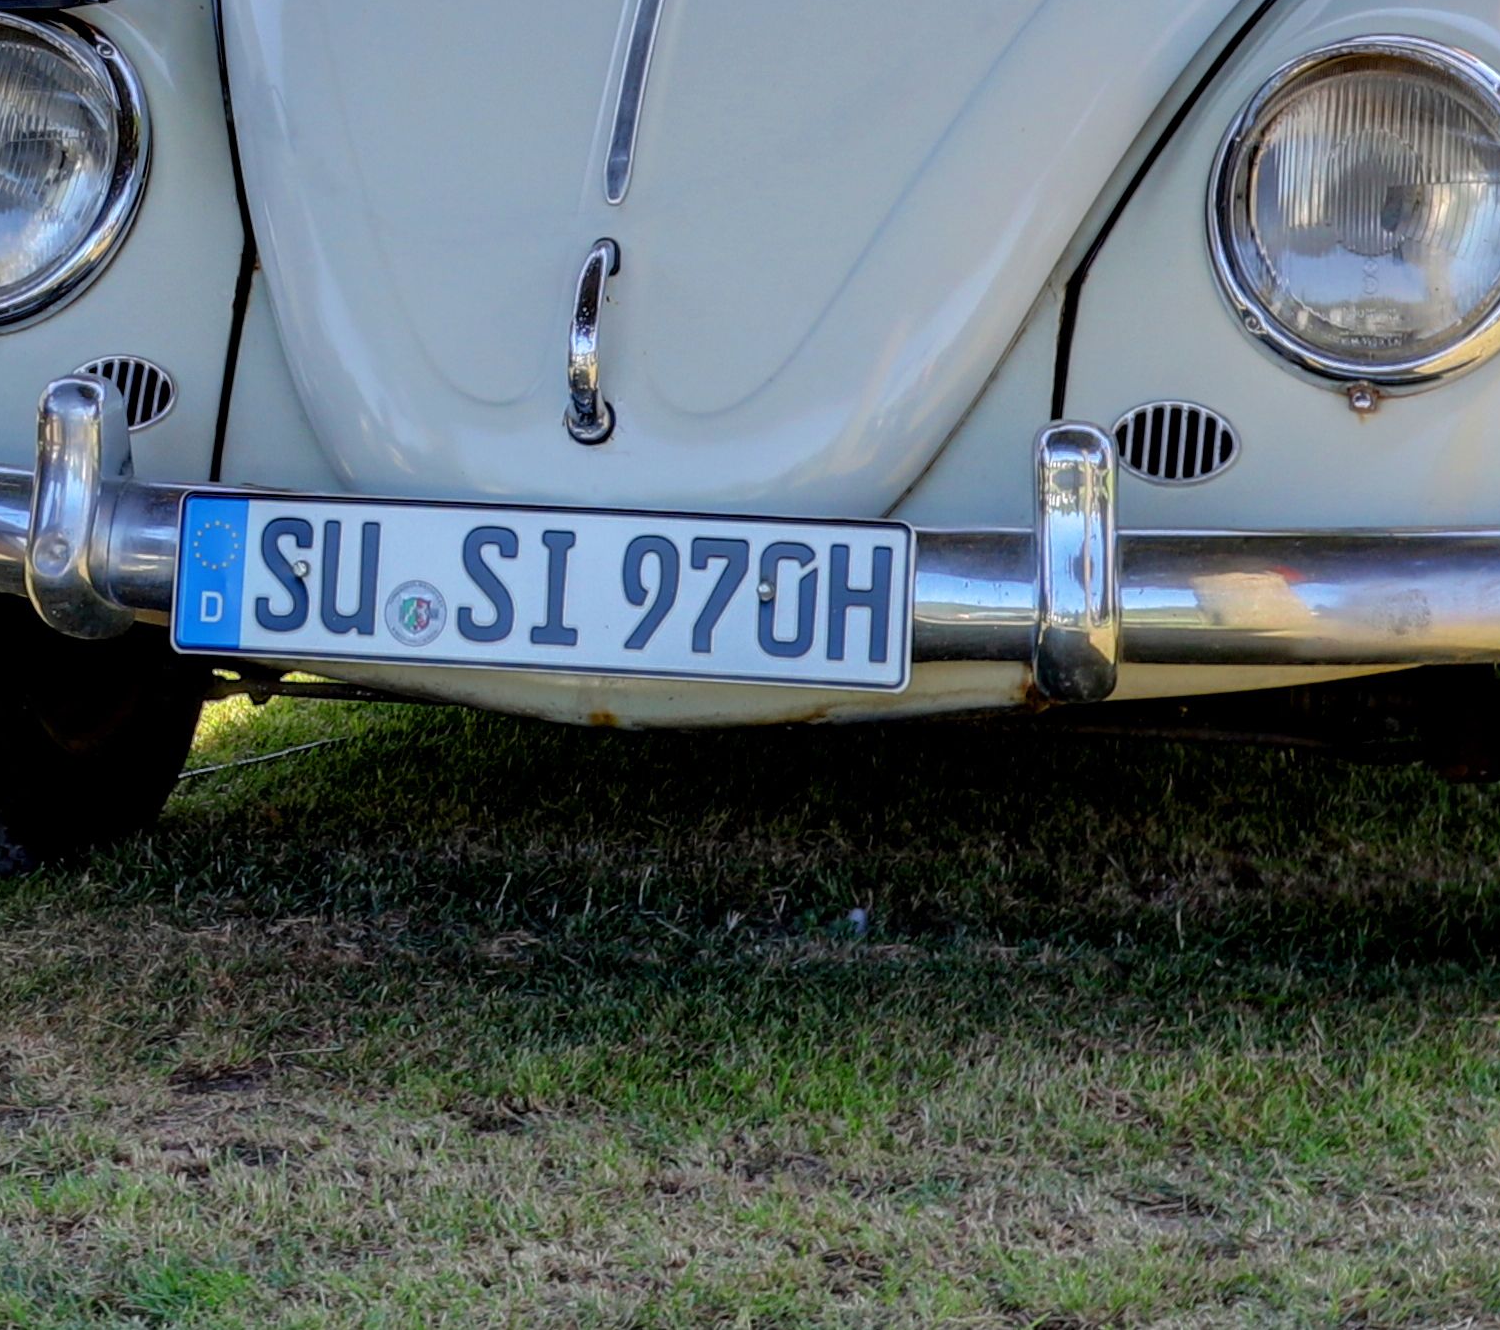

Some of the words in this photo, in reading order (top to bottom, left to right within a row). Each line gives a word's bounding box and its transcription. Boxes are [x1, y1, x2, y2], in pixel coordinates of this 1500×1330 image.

[200, 592, 223, 624] D
[254, 517, 381, 637] SU
[456, 525, 578, 647] SI
[622, 533, 893, 664] 970H
